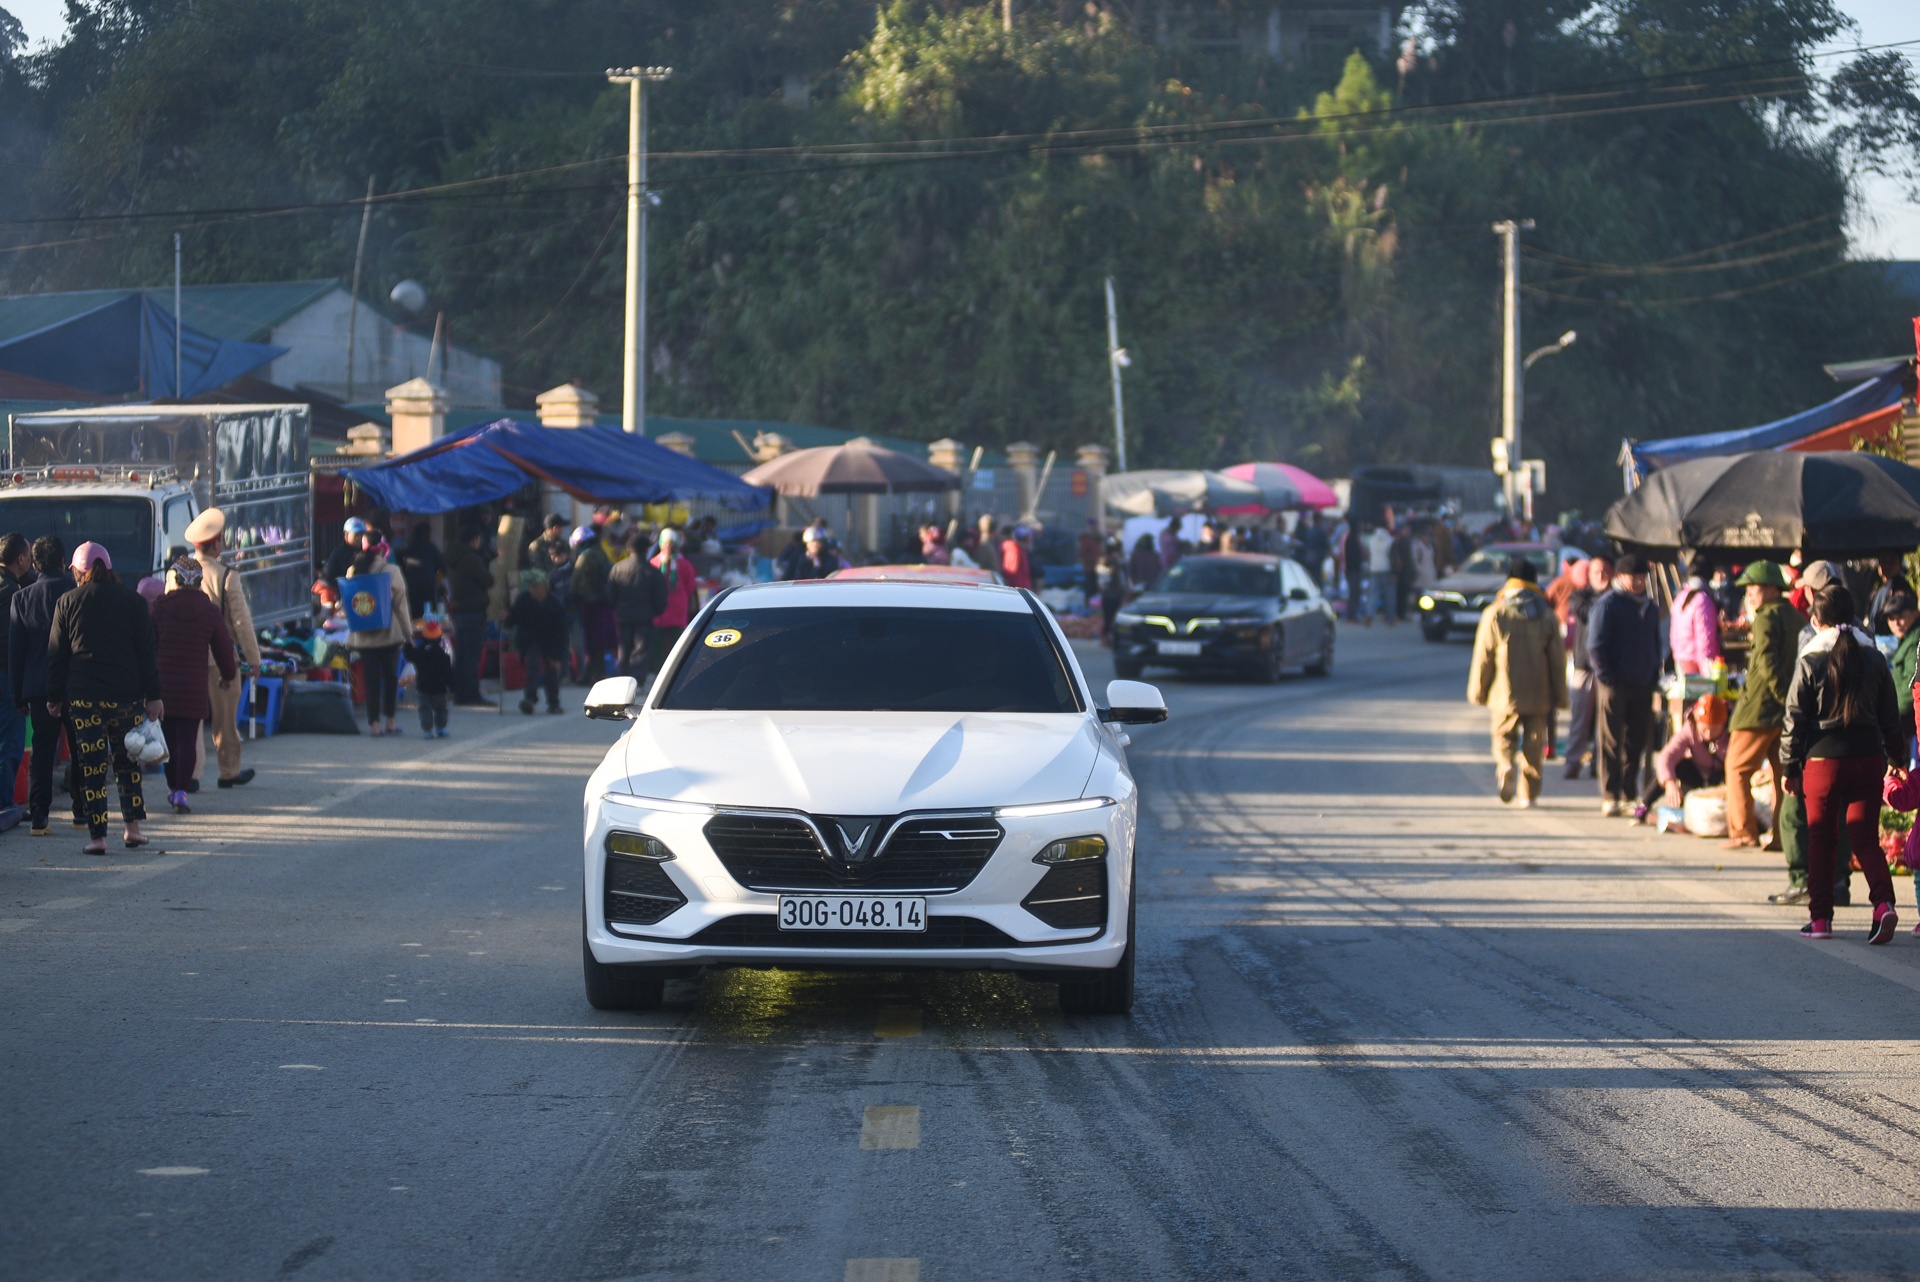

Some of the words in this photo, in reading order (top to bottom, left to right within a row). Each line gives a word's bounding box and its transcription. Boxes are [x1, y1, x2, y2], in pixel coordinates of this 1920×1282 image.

[713, 634, 733, 643] 36
[75, 714, 102, 730] D&G
[81, 738, 106, 753] D&G
[83, 762, 107, 777] D&G
[783, 900, 921, 927] 30G-048.14
